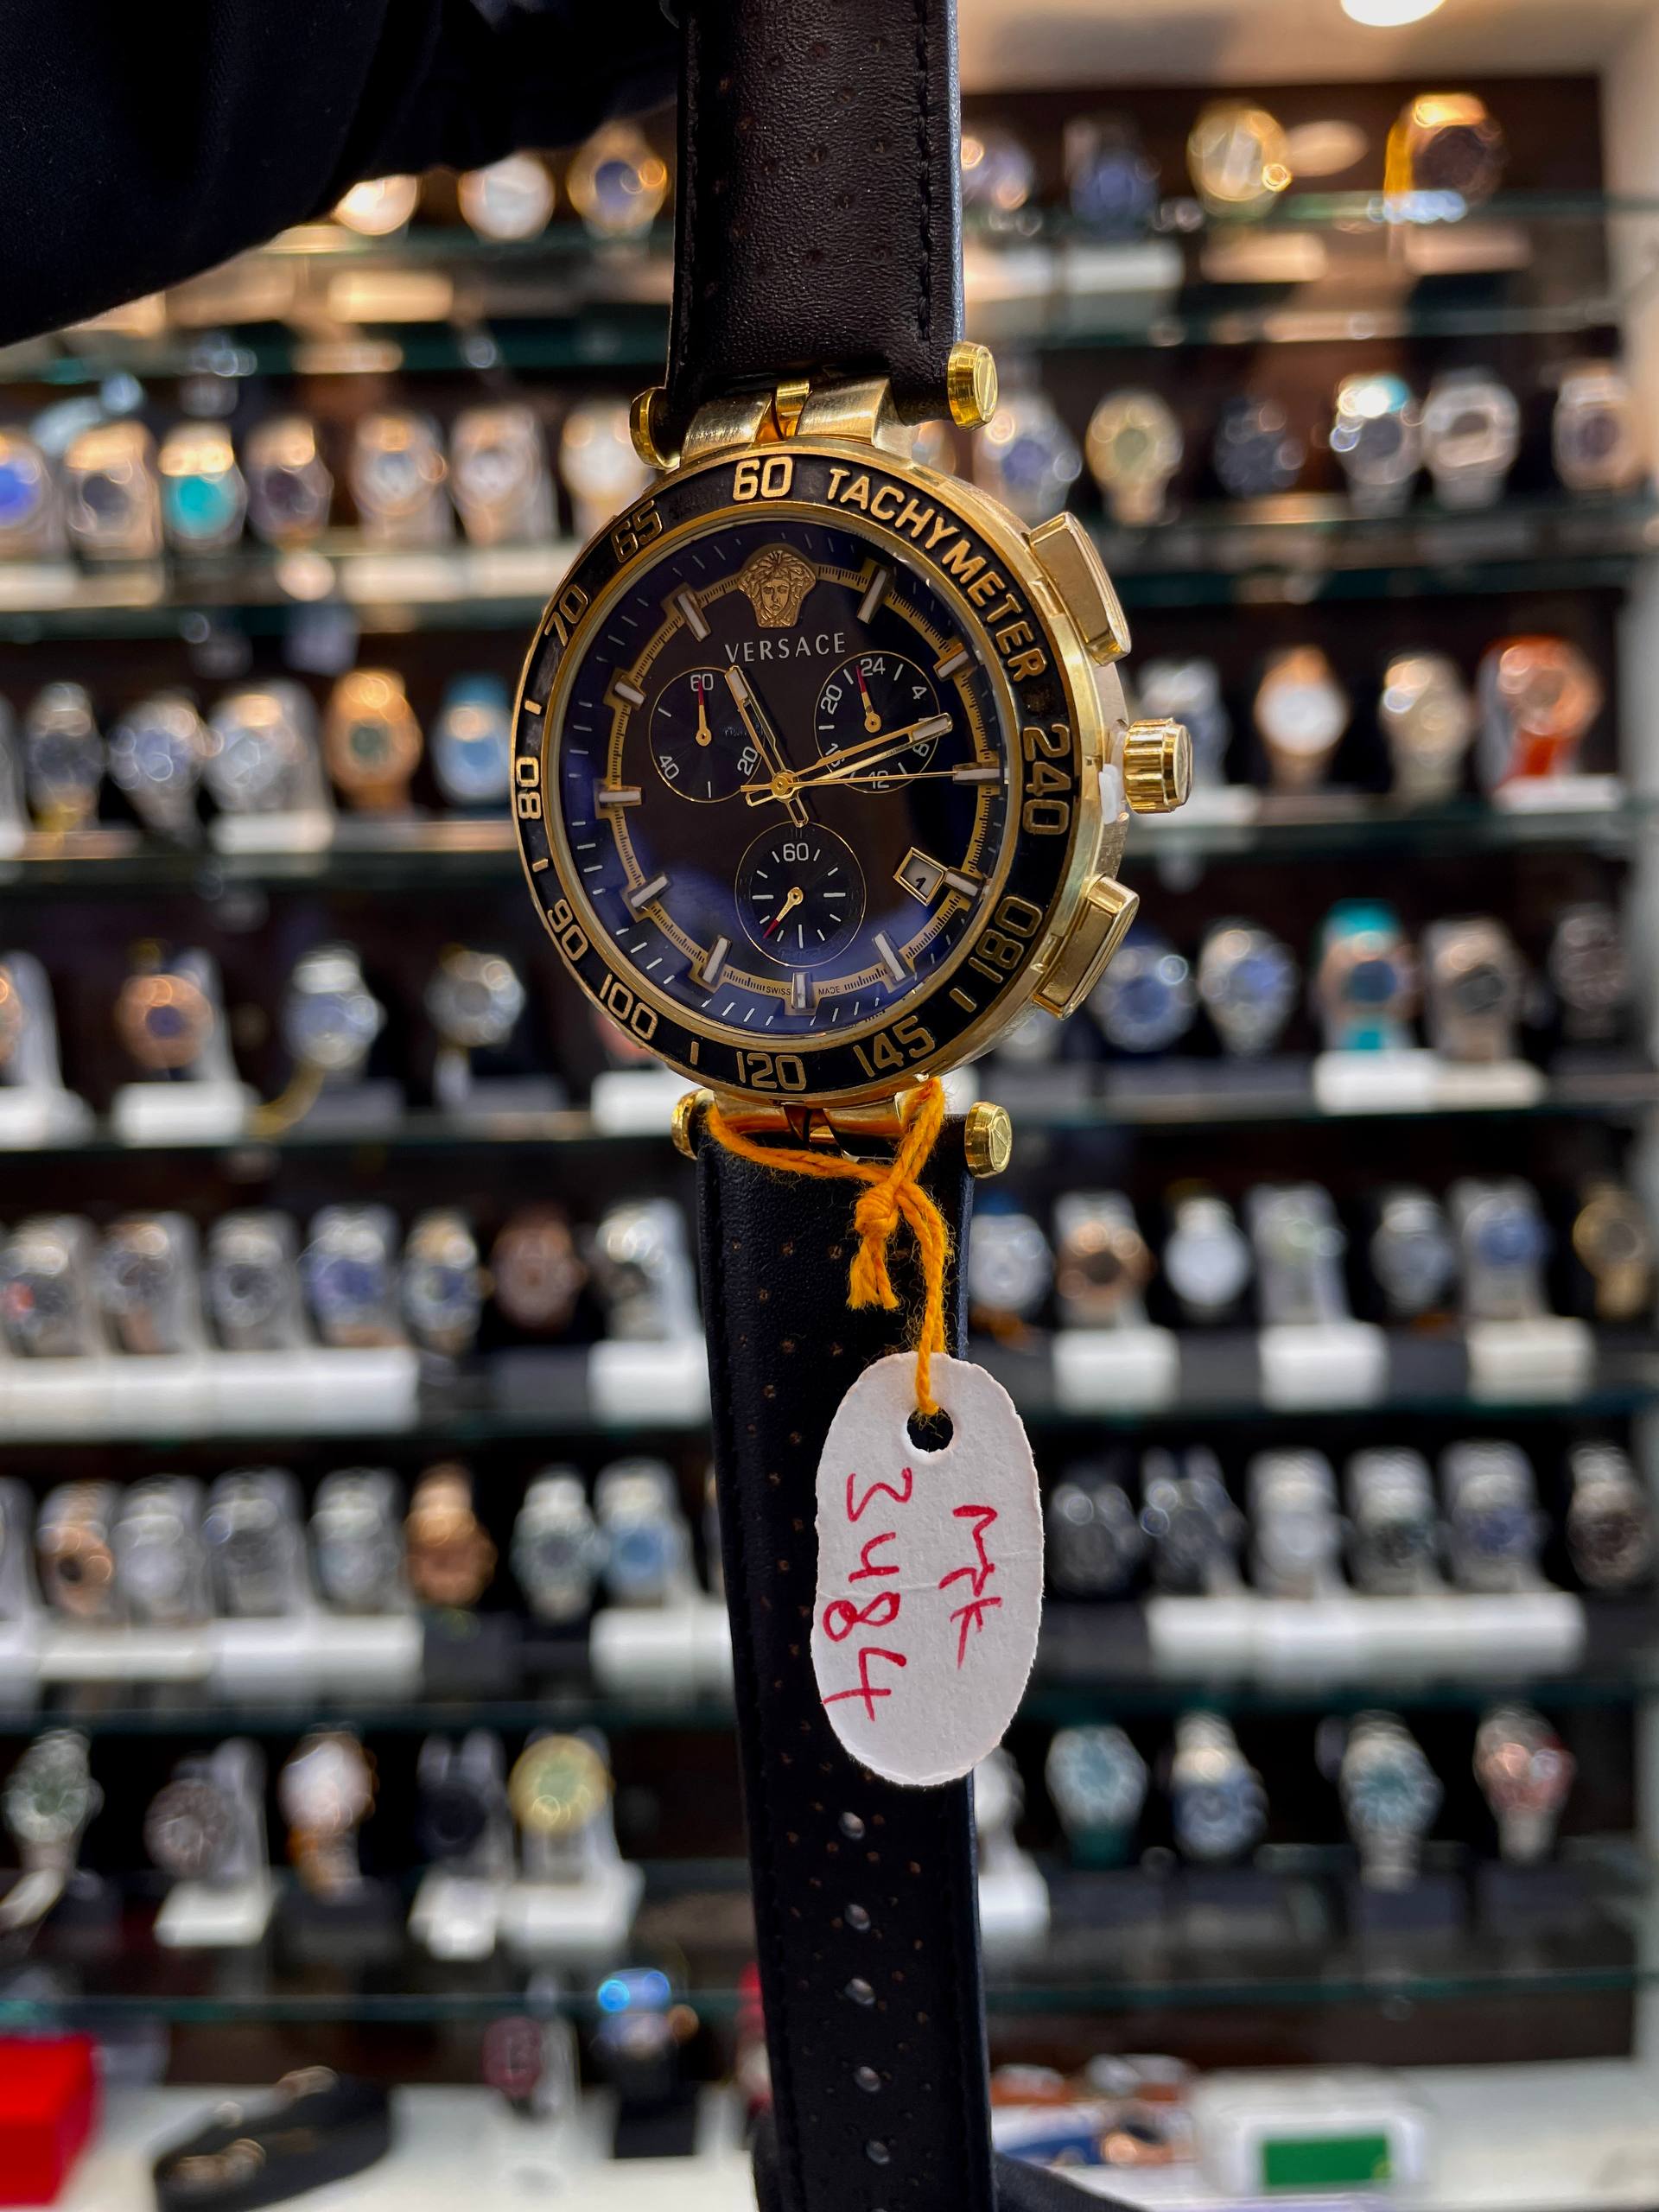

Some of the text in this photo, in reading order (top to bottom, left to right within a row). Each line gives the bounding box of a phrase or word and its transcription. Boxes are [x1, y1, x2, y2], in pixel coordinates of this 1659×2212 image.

[732, 455, 794, 501] 60
[609, 499, 664, 563] 65
[826, 467, 1048, 683] TACHYMETER
[543, 583, 591, 647] 70
[724, 632, 847, 664] VERSACE
[860, 657, 886, 677] 24
[690, 673, 715, 692] 60
[819, 683, 843, 715] 20
[912, 683, 927, 700] 4
[658, 754, 680, 780] 40
[737, 746, 759, 776] 20
[868, 770, 891, 790] 12
[1023, 722, 1072, 836] 240
[515, 756, 542, 820] 80
[782, 842, 810, 862] 60
[546, 898, 588, 962] 90
[968, 895, 1043, 984] 180
[598, 973, 658, 1041] 100
[766, 985, 842, 996] SWISS MADE
[852, 1015, 936, 1078] 145
[735, 1051, 807, 1091] 120
[822, 1466, 913, 1722] 3484
